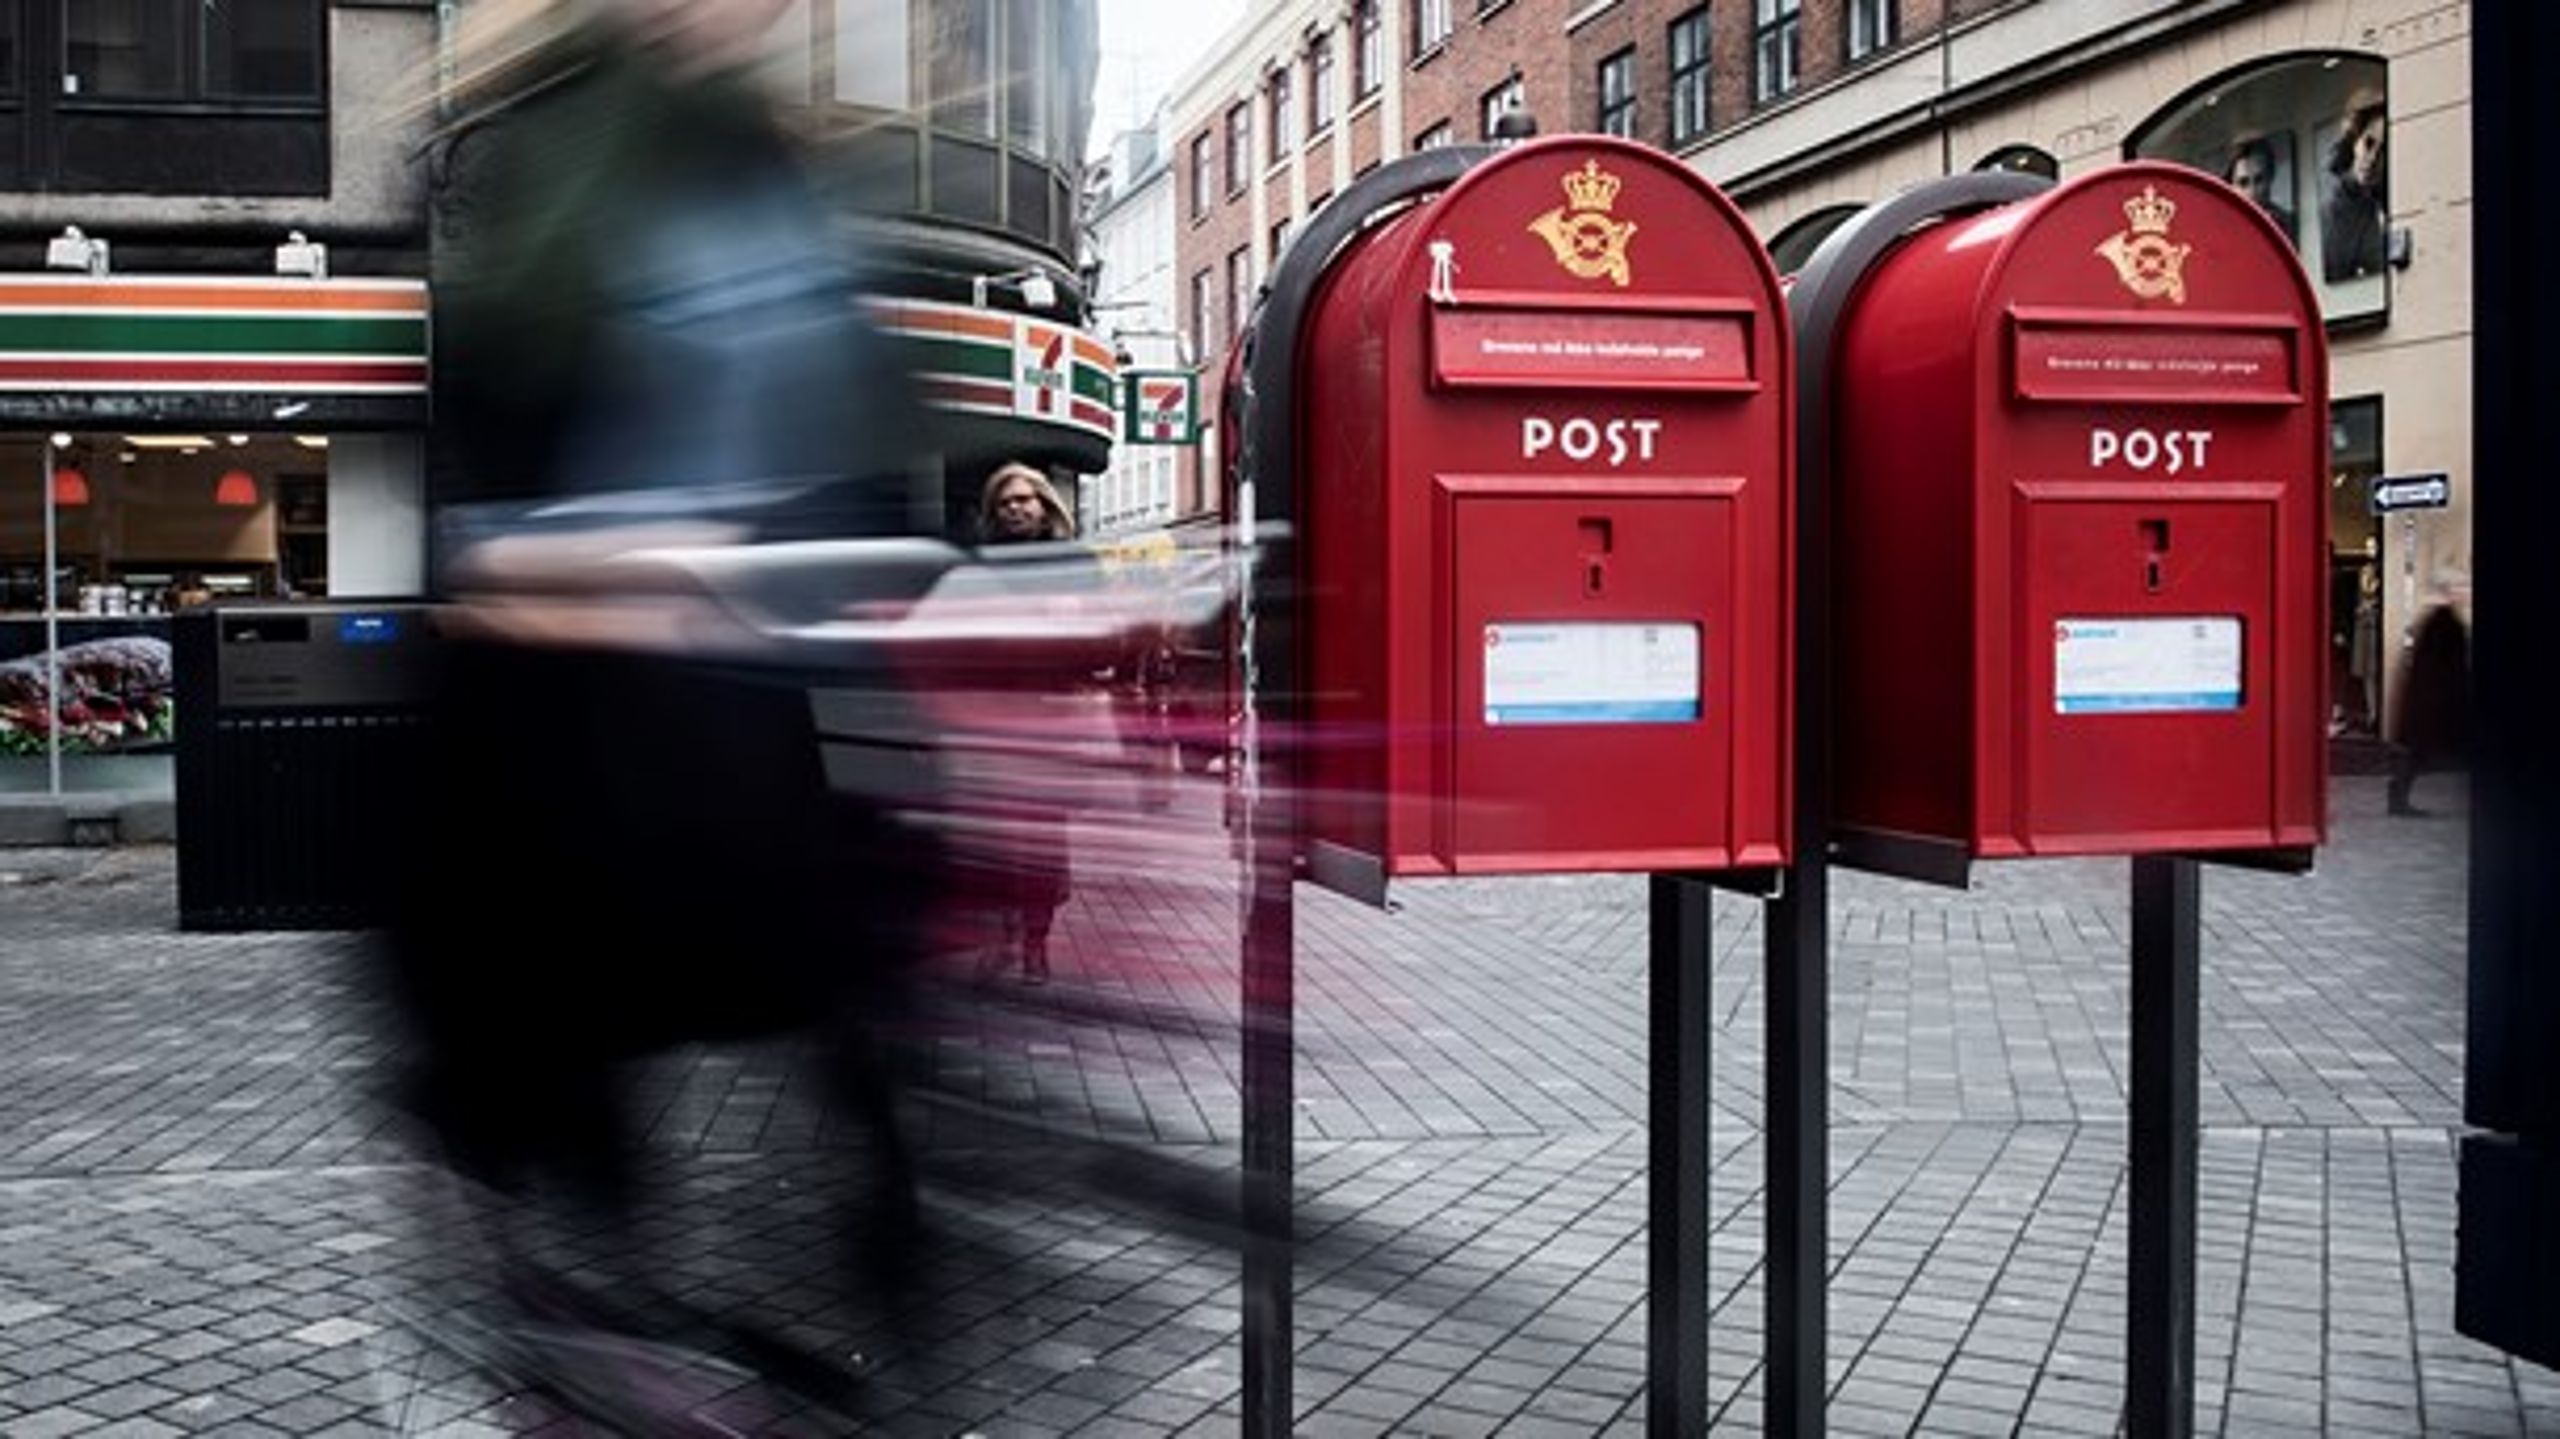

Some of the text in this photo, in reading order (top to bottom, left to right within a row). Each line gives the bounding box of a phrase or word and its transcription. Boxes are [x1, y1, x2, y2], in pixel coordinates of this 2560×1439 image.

[1027, 326, 1063, 414] 7
[1142, 382, 1184, 439] 7
[1522, 417, 1662, 467] POST
[2092, 429, 2213, 475] POST
